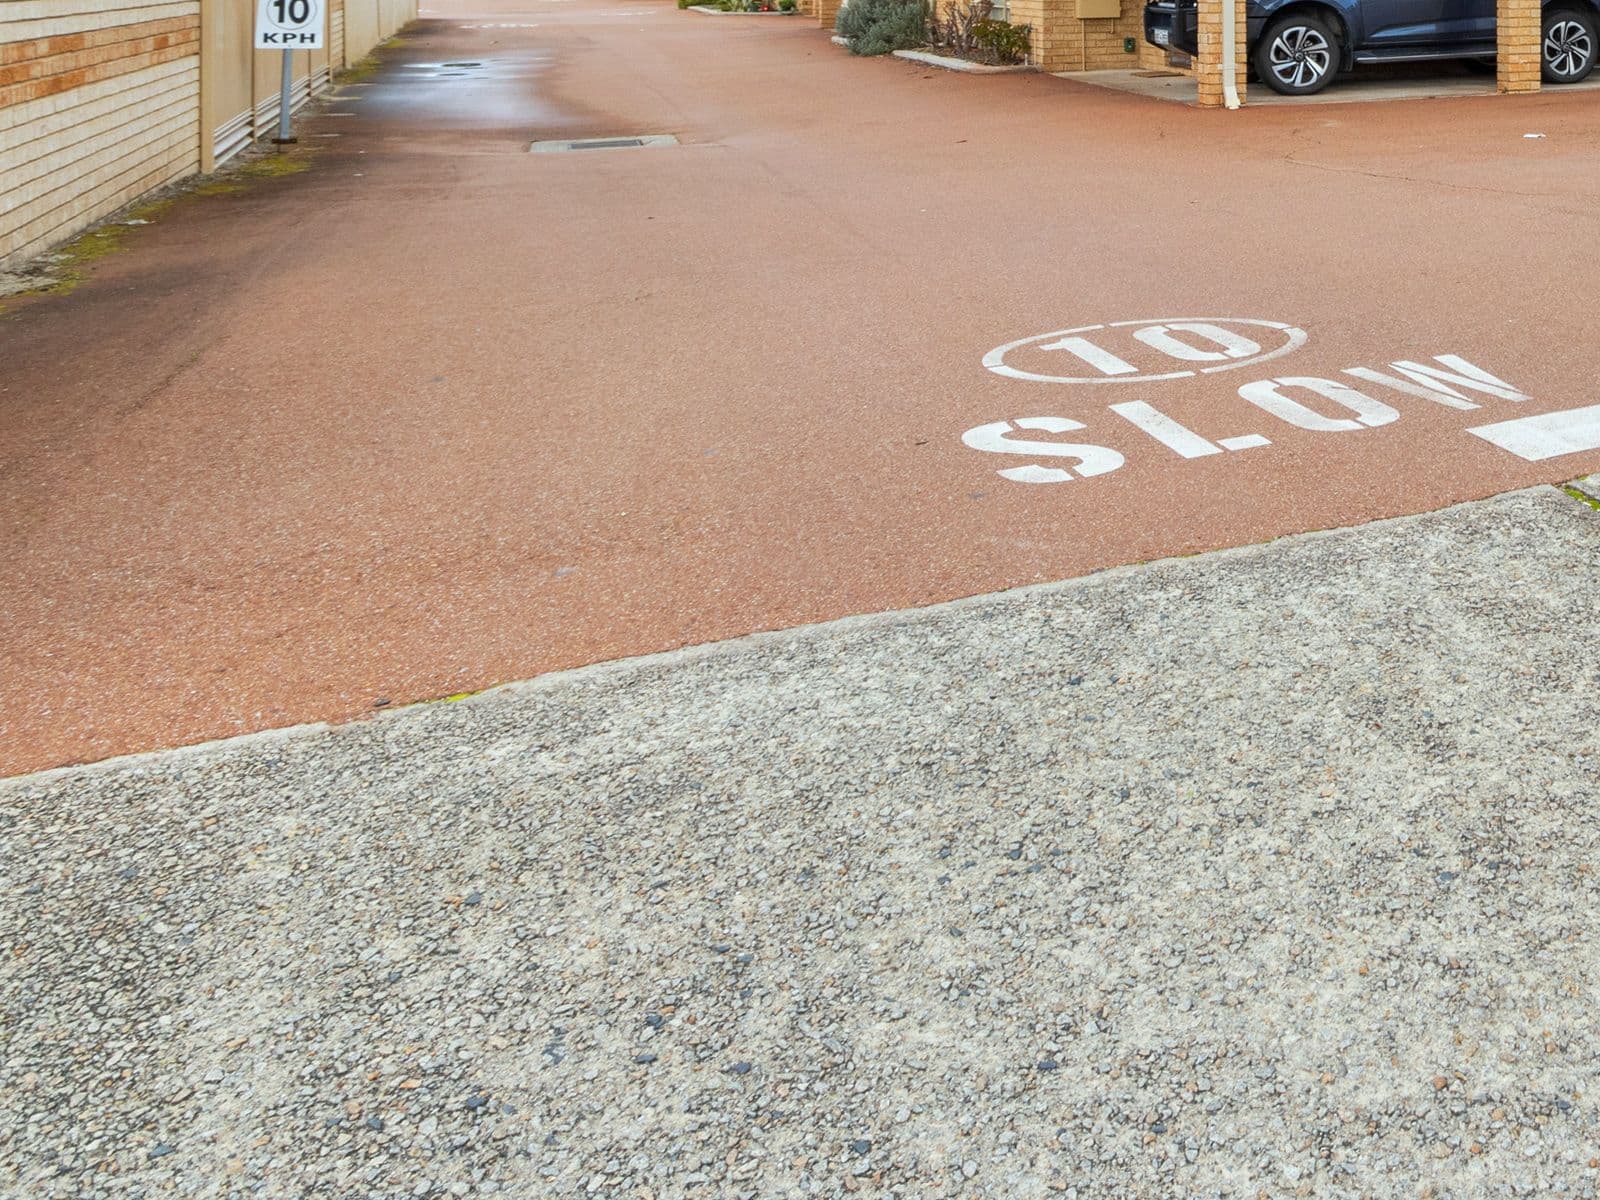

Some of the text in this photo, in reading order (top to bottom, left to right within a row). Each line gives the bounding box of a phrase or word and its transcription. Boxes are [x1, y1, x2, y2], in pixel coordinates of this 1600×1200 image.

[263, 33, 315, 44] KPH
[1039, 323, 1261, 376] 10
[961, 354, 1533, 484] SLOW
